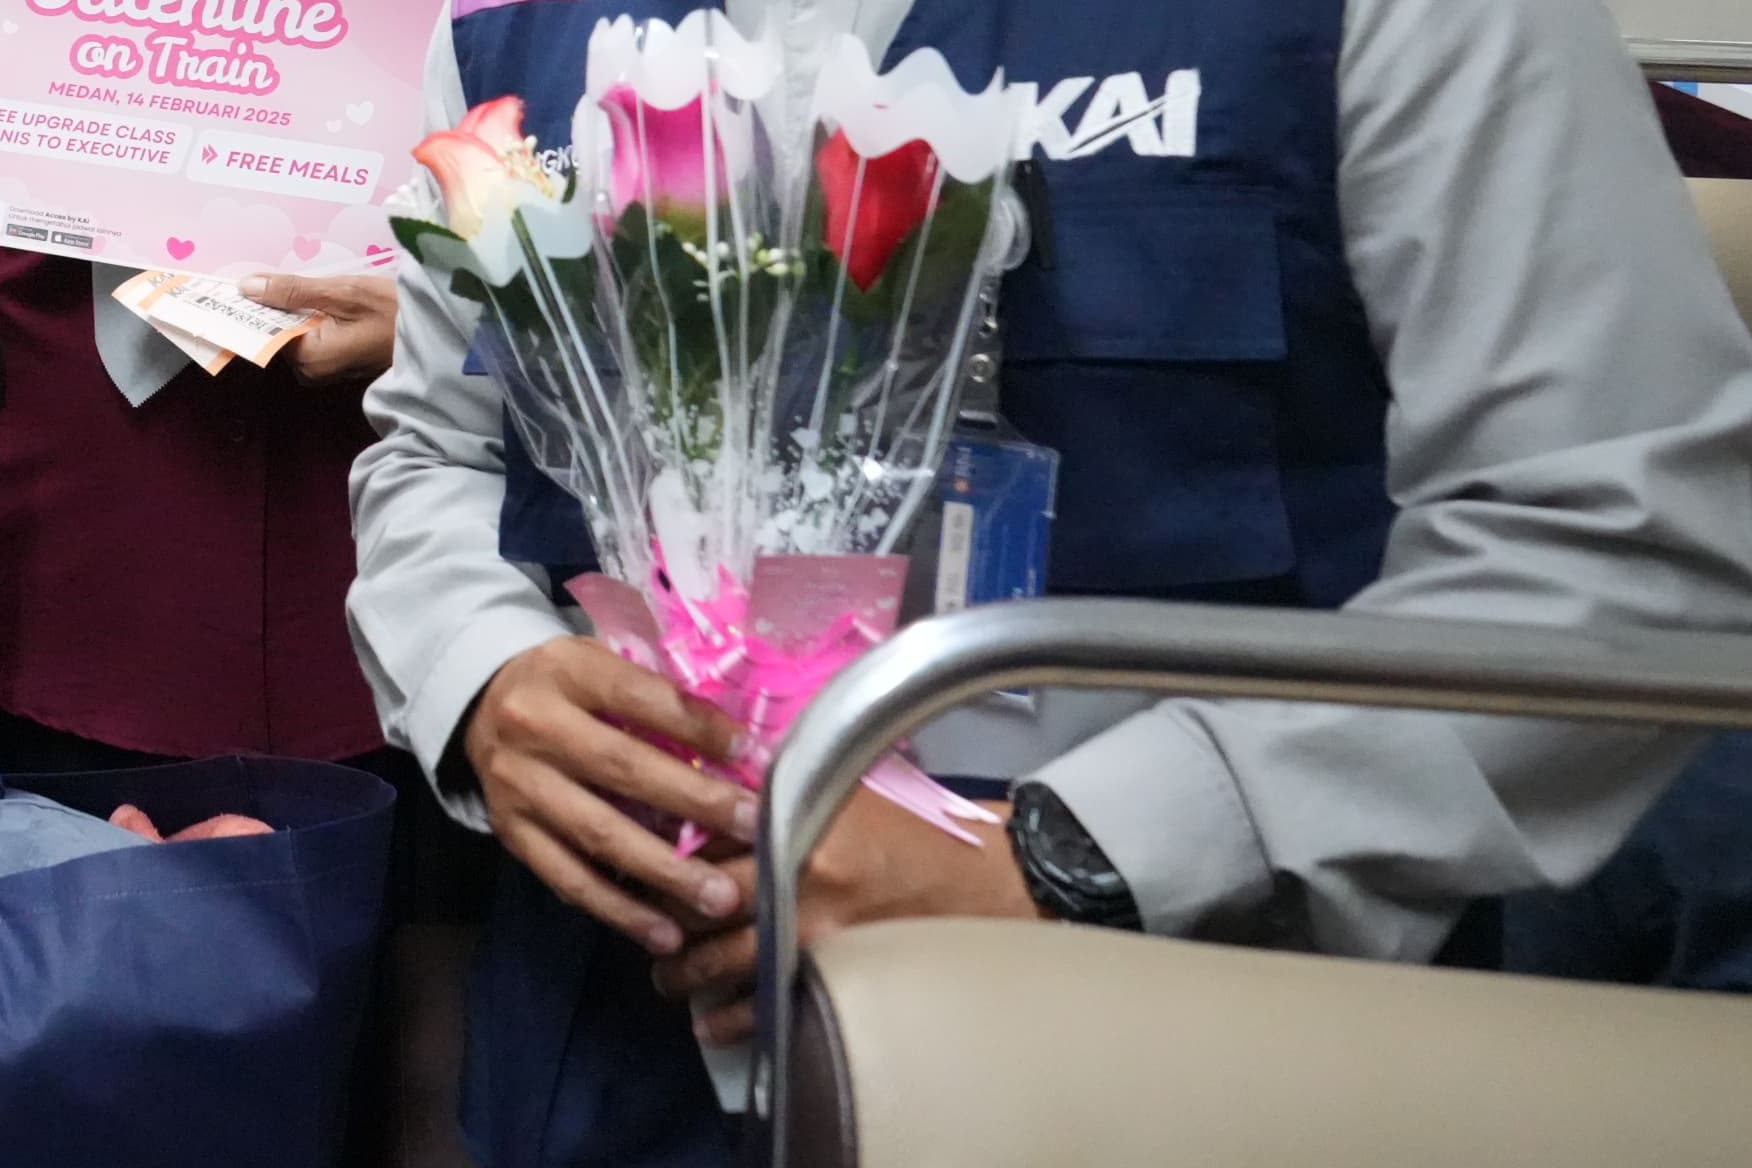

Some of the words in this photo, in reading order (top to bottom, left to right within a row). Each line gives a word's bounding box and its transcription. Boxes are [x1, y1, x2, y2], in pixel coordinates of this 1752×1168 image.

[75, 39, 138, 73] on
[147, 35, 274, 89] Train
[48, 81, 121, 105] MEDAN,
[127, 92, 145, 107] 14
[149, 94, 241, 120] FEBRUARI
[242, 107, 292, 127] 2025
[1005, 68, 1202, 160] KAI
[22, 112, 112, 137] UPGRADE
[115, 125, 177, 146] CLASS
[36, 134, 62, 150] TO
[65, 138, 171, 165] EXECUTIVE
[226, 151, 285, 174] FREE
[288, 159, 369, 186] MEALS
